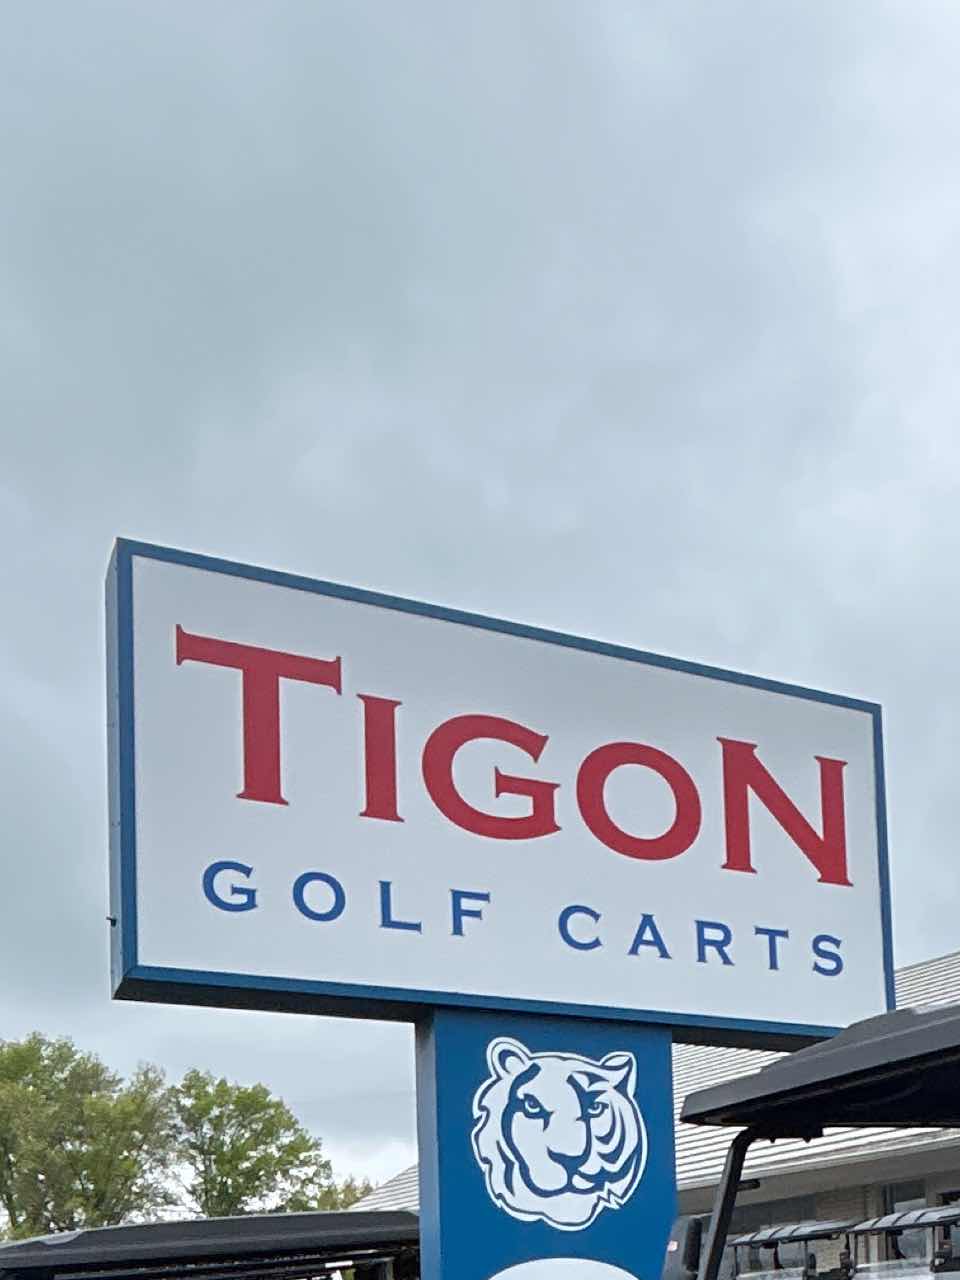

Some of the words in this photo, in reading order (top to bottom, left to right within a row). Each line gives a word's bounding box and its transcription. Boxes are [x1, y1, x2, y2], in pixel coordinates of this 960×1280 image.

[175, 624, 854, 887] TIGON
[201, 859, 492, 938] GOLF
[557, 903, 846, 977] CARTS
